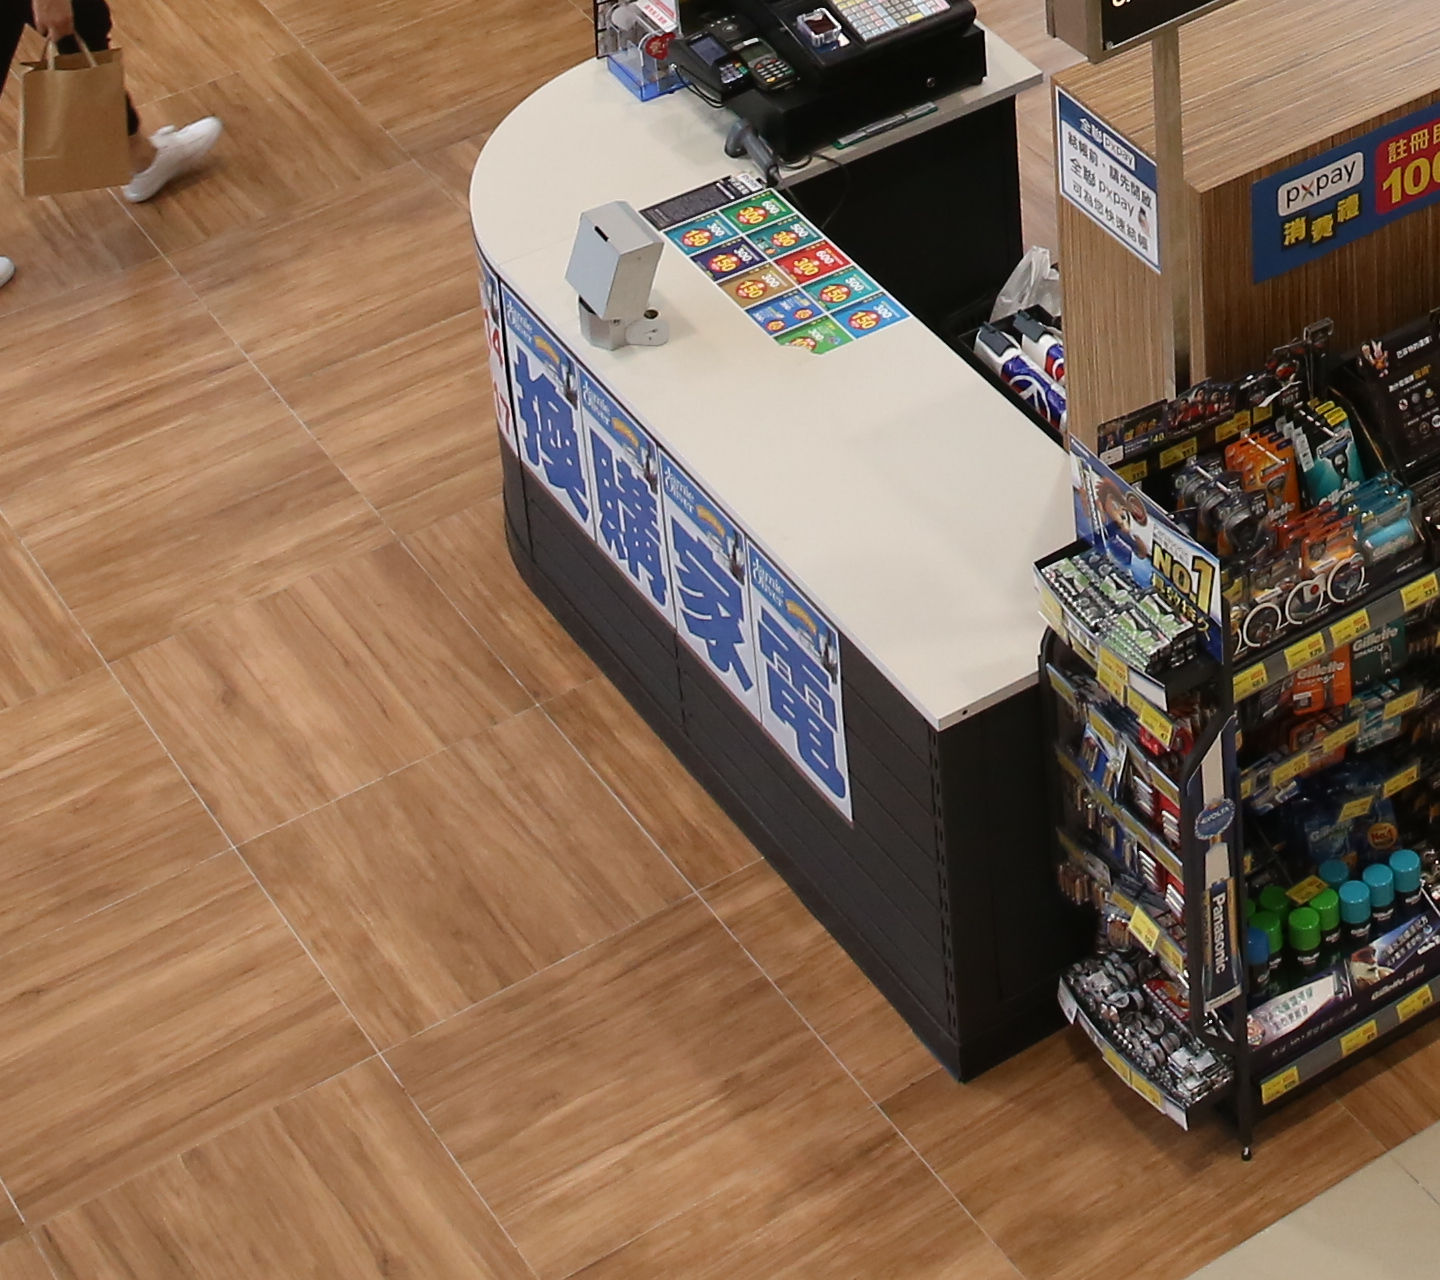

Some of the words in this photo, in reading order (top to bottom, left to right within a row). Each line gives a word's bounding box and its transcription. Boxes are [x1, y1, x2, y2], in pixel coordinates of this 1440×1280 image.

[1105, 136, 1135, 167] pxpay
[1070, 157, 1096, 188] 全聯
[1098, 180, 1135, 218] pxpay
[1285, 159, 1356, 209] pxpay
[1283, 192, 1360, 246] 消費禮
[505, 296, 534, 332] Jamie
[581, 379, 612, 415] Jamie
[662, 464, 695, 499] Jamie
[751, 557, 785, 592] Jamie
[1297, 659, 1346, 680] Gillette
[1212, 891, 1226, 975] Panasonic
